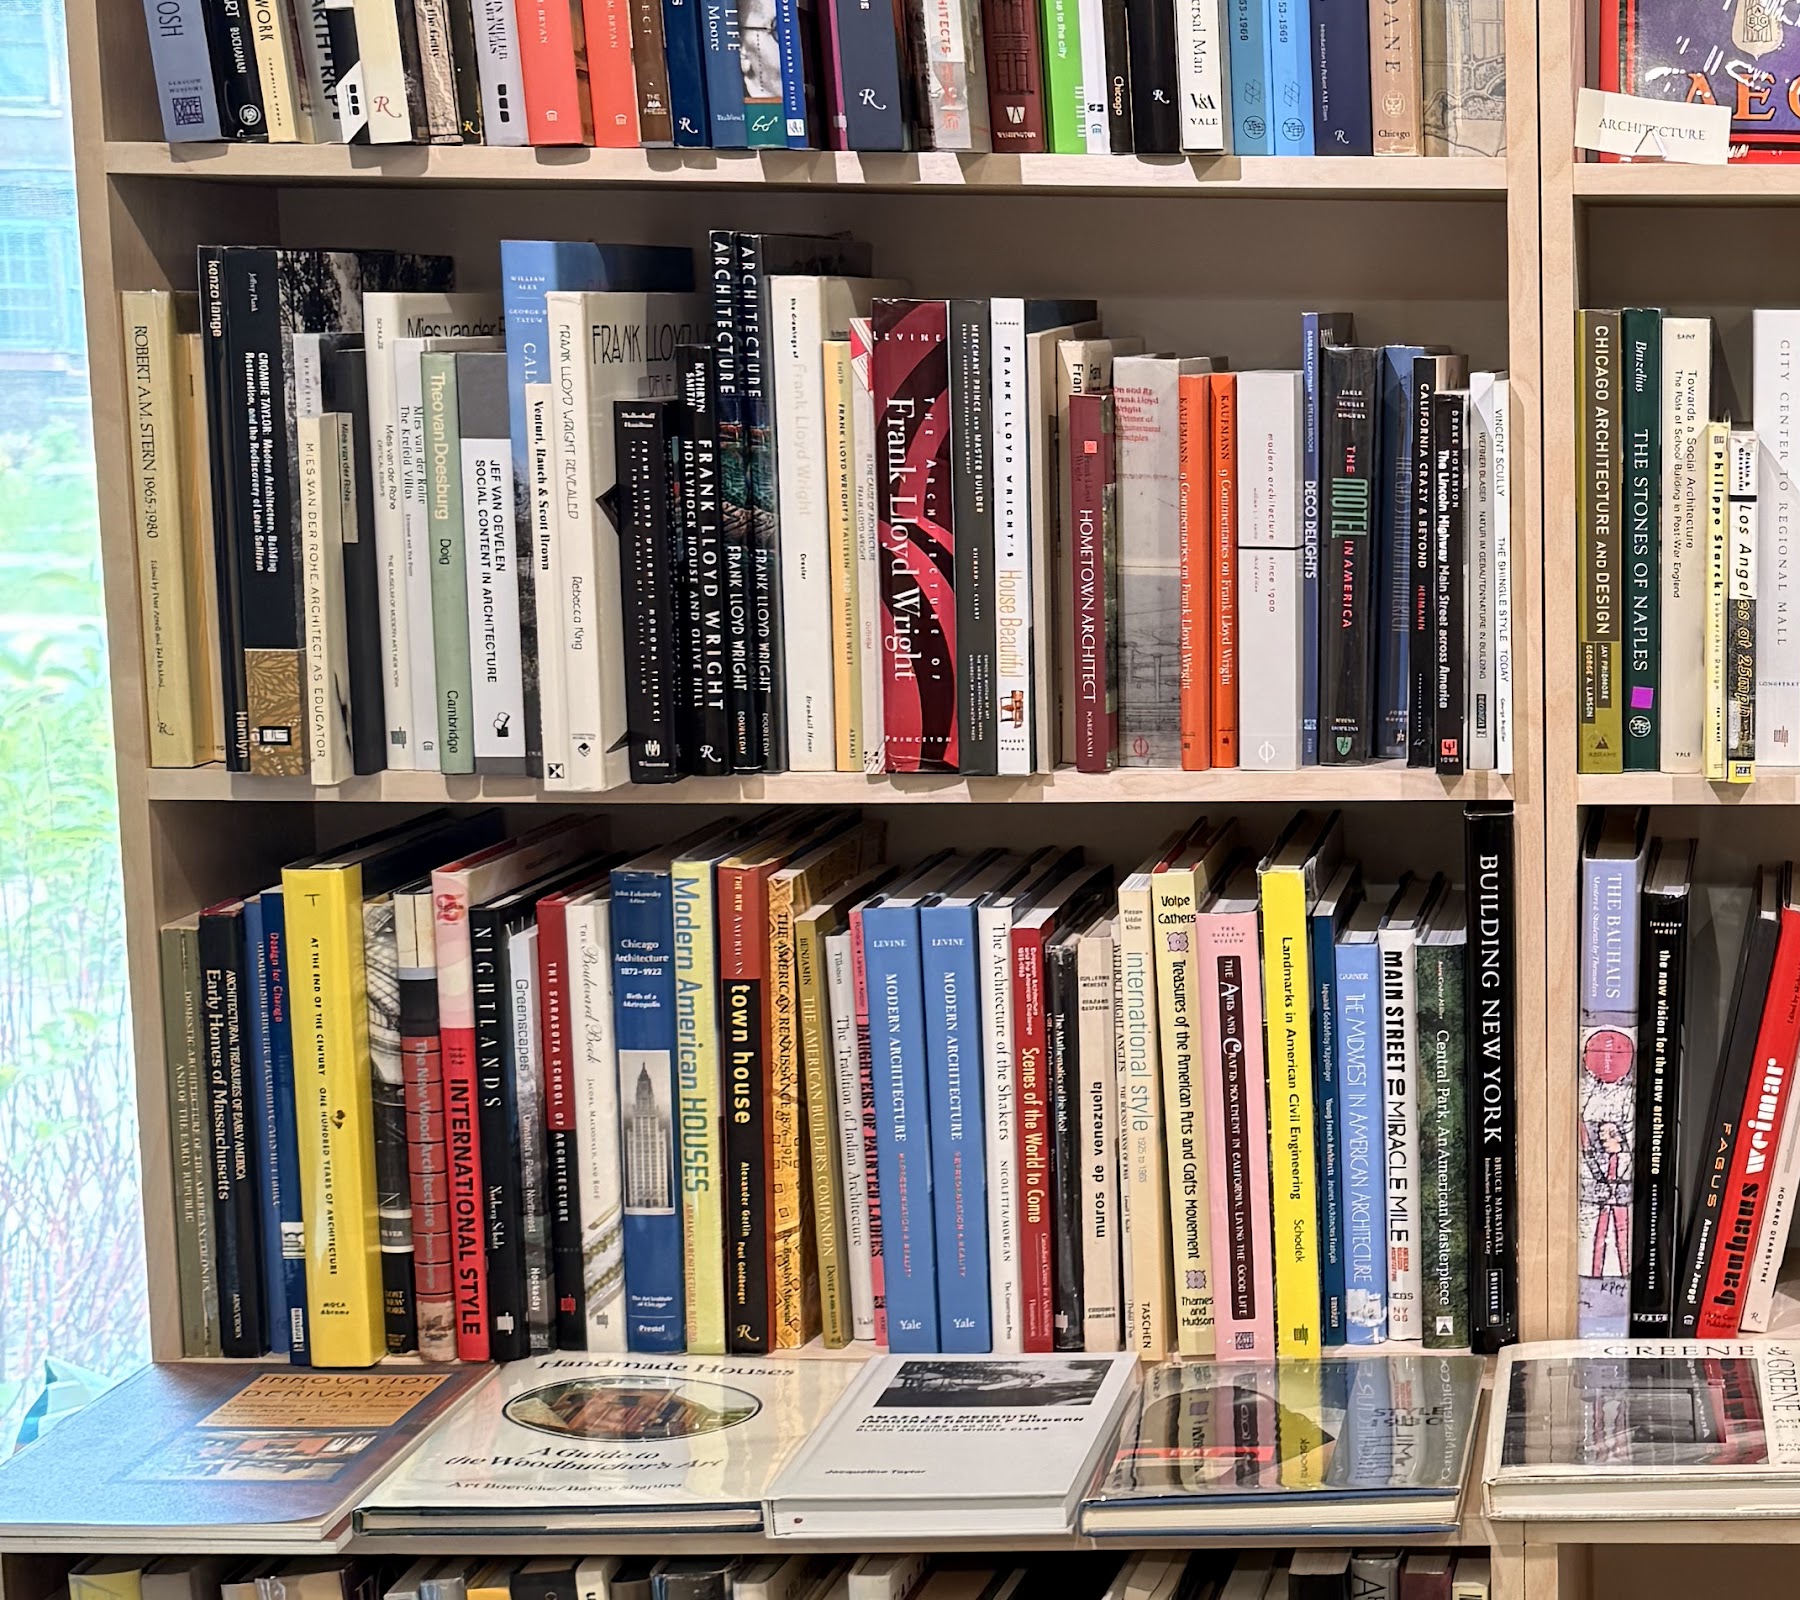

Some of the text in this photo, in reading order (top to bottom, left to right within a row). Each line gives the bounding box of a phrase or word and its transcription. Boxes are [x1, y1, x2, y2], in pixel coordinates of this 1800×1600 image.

[1190, 116, 1218, 126] YALE
[1598, 116, 1706, 142] ARCHITECTURE
[885, 398, 920, 680] Frank Lloyd Wright
[1330, 478, 1368, 539] MOTEL
[1594, 326, 1609, 634] CHICAGO ARCHITECTURE AND DESIGN
[697, 441, 723, 710] FRANK LLOYD WRIGHT
[446, 690, 459, 754] Cambridge
[731, 986, 753, 1123] town house
[1480, 854, 1502, 1144] BUILDING NEW YORK
[1744, 1059, 1785, 1175] weimar
[450, 1079, 479, 1333] INTERNATIONAL STYLE
[1713, 1182, 1760, 1308] bauhaus
[1140, 1301, 1150, 1348] TASCHEN
[1602, 1345, 1755, 1356] GREENE
